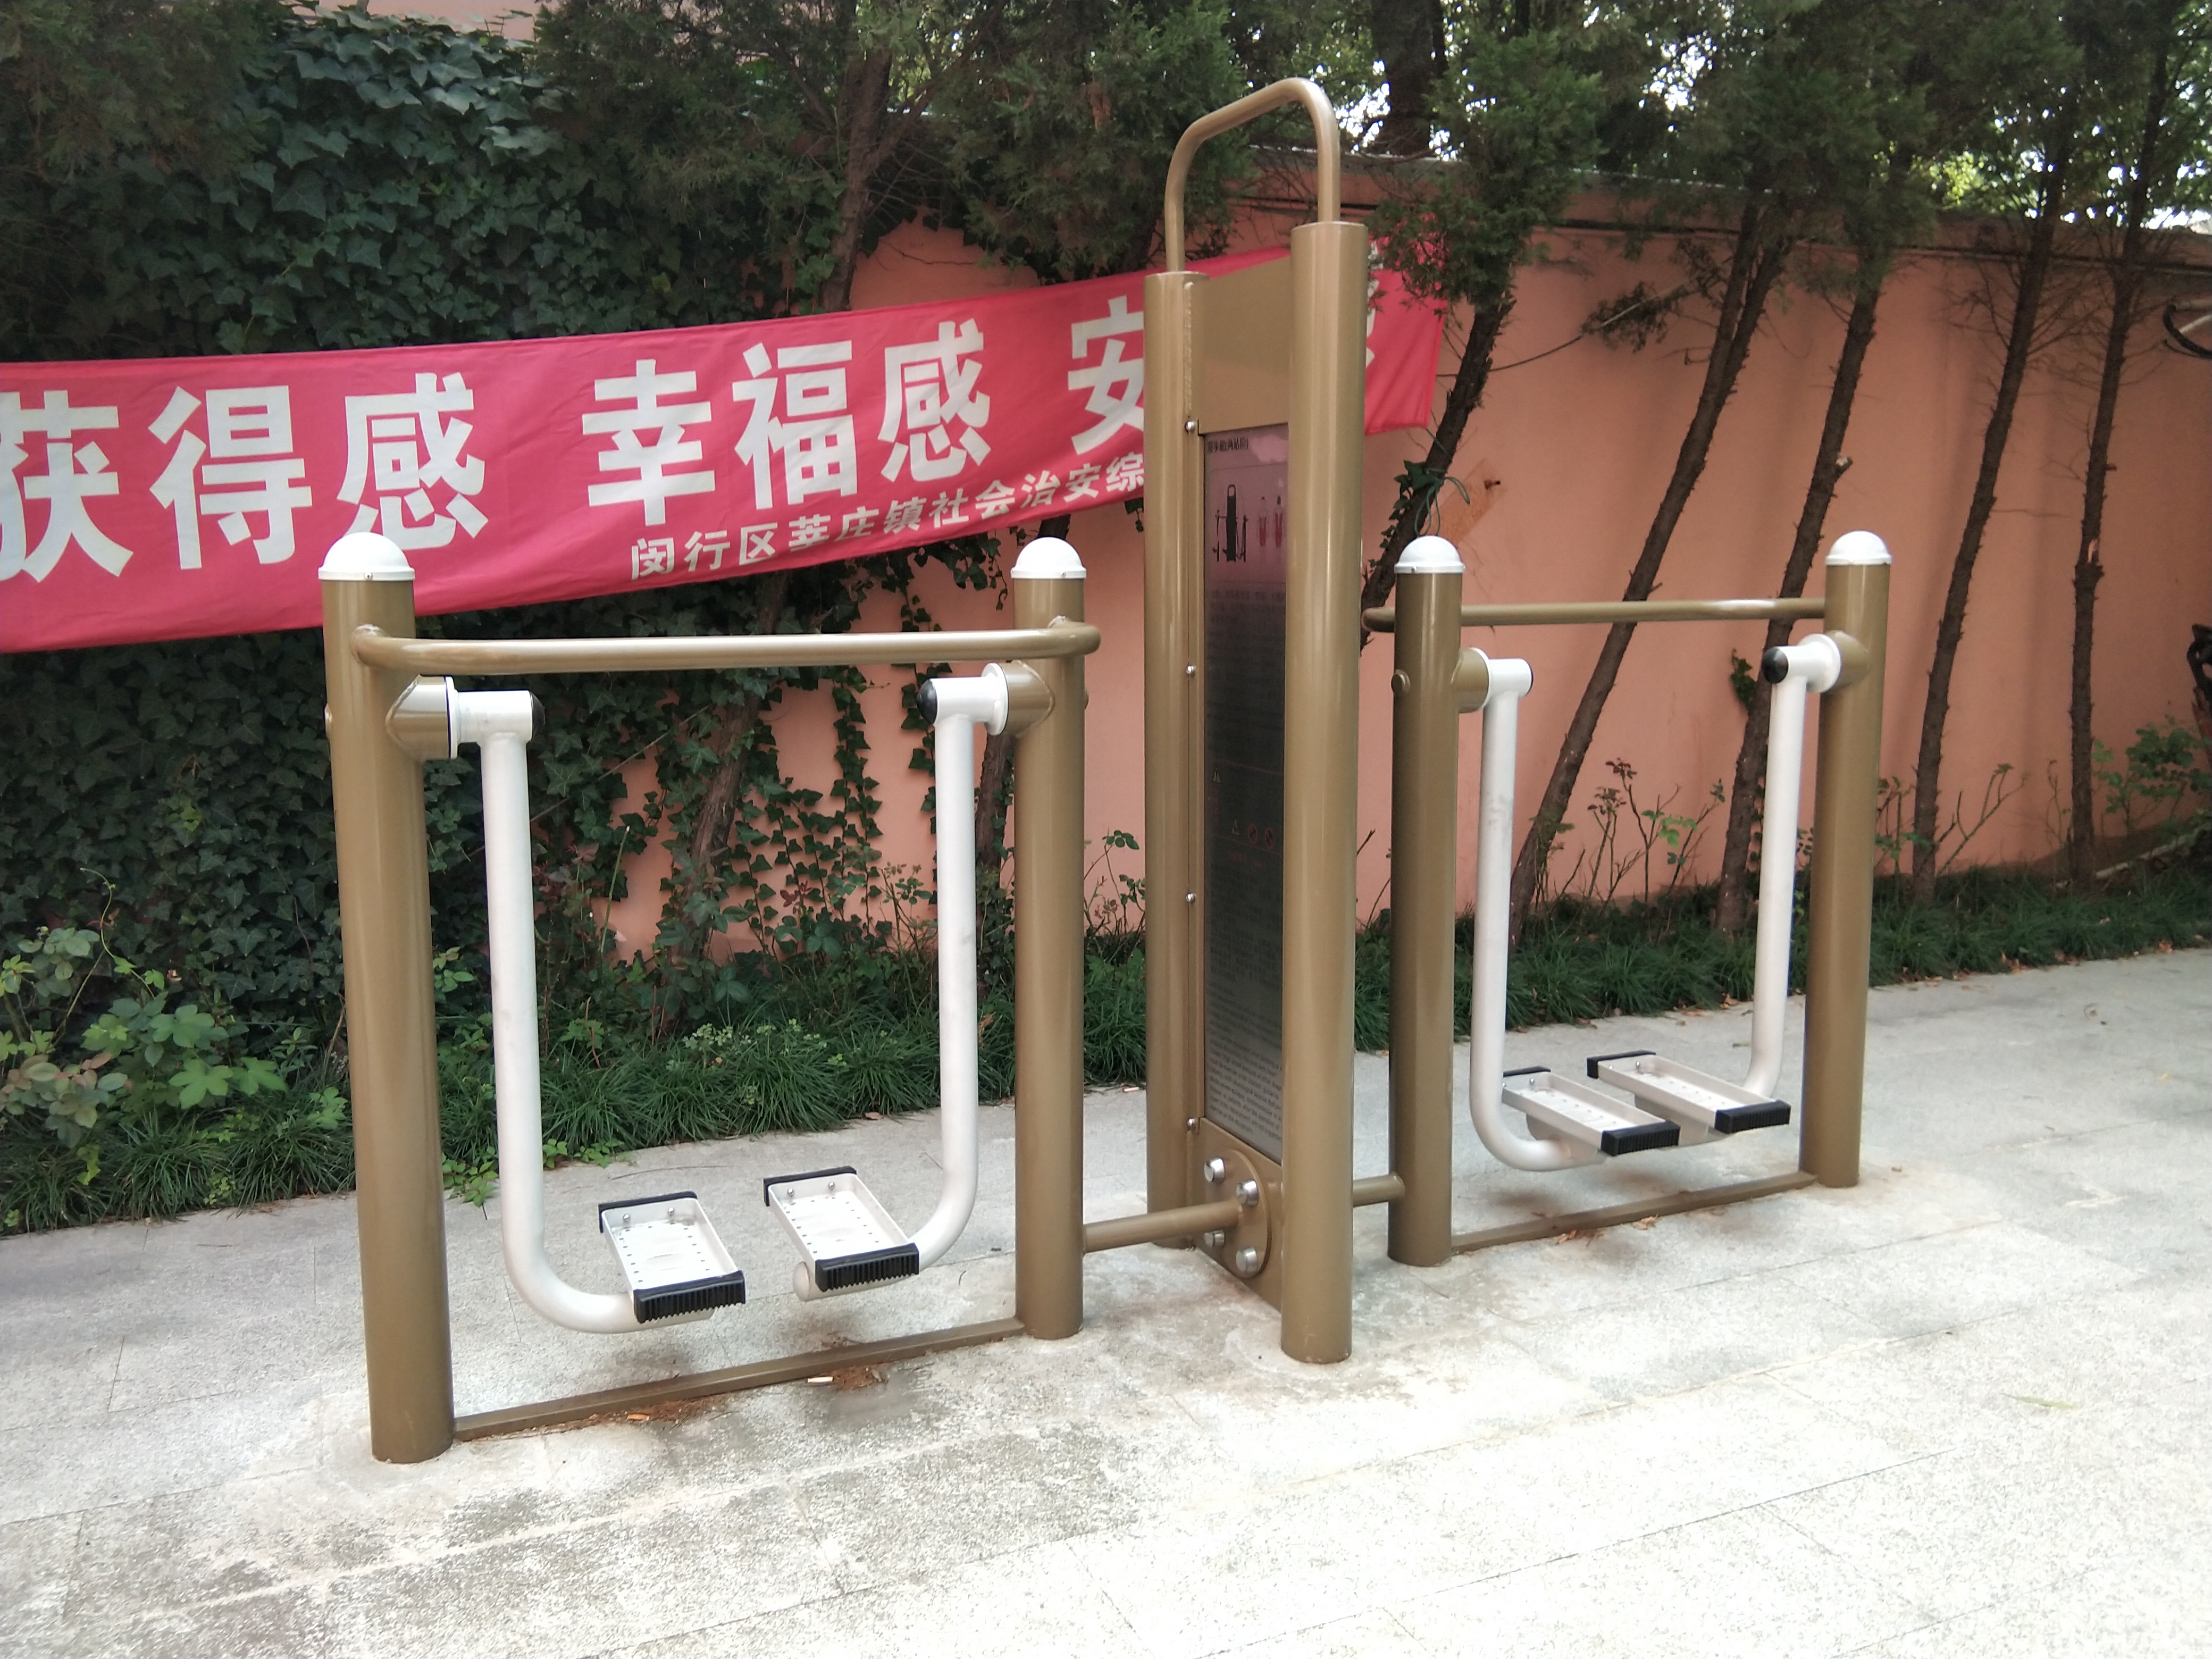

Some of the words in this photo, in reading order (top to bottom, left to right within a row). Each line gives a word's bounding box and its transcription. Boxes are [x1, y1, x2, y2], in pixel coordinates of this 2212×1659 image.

[0, 372, 489, 582] 获得感
[582, 318, 991, 526] 幸福感
